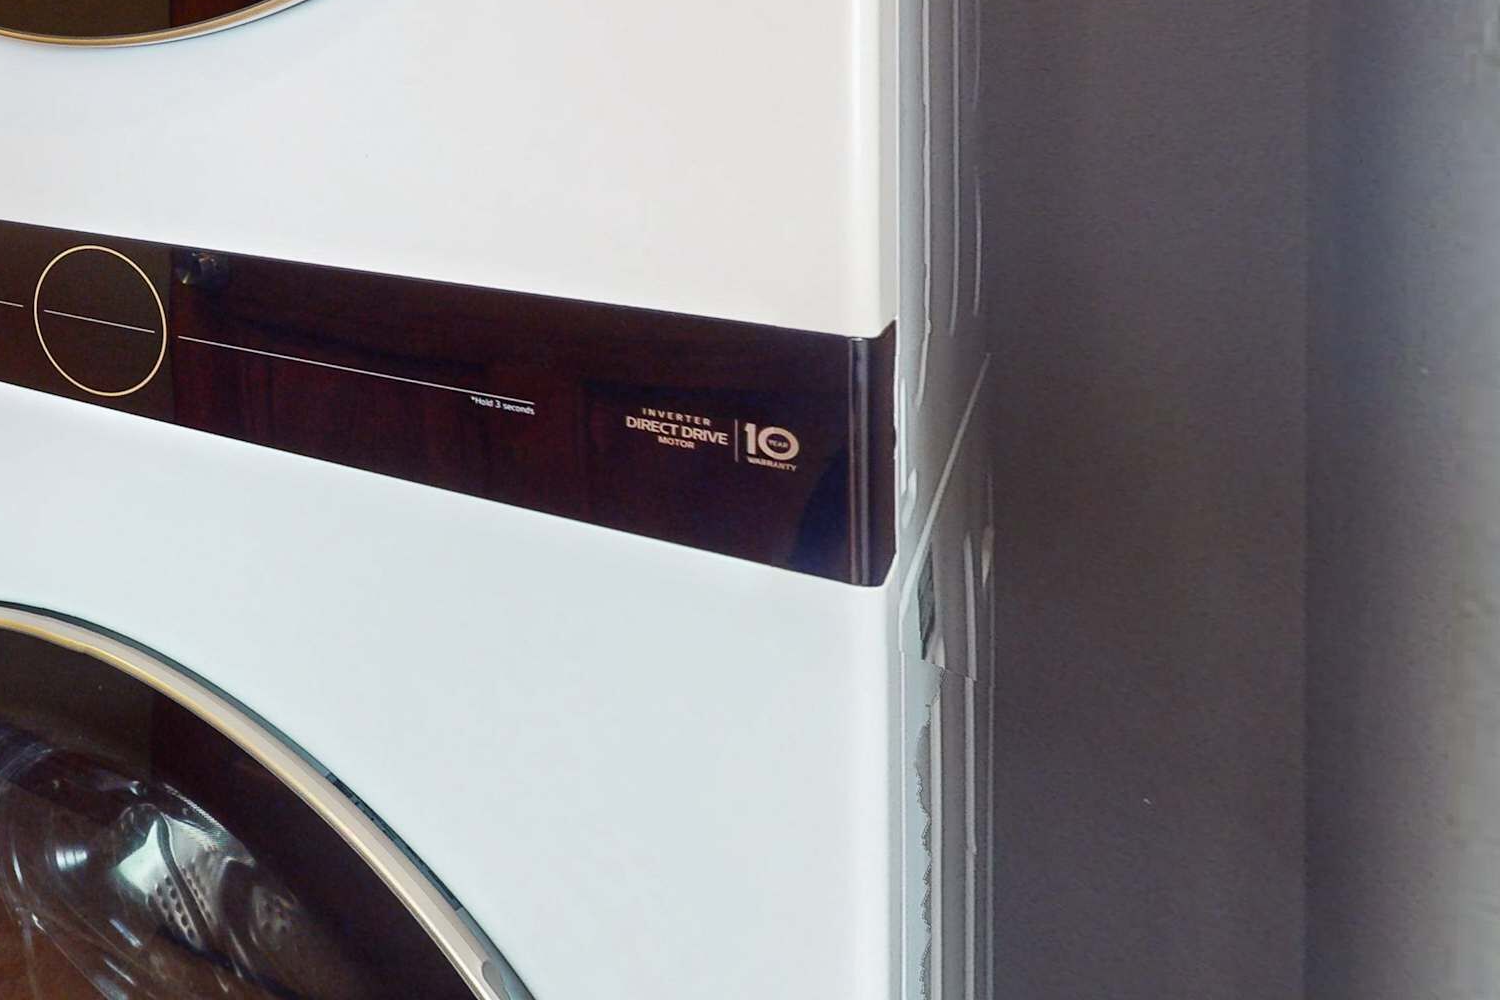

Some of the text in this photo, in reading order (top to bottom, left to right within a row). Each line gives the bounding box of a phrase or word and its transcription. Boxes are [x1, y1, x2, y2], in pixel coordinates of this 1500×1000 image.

[502, 403, 536, 416] seconds
[642, 407, 712, 427] INVERTER
[625, 415, 729, 446] DIRECT DRIVE
[658, 435, 695, 449] MOTOR
[744, 422, 800, 461] 10
[767, 438, 789, 449] YEAR
[747, 456, 797, 472] WARRANTY
